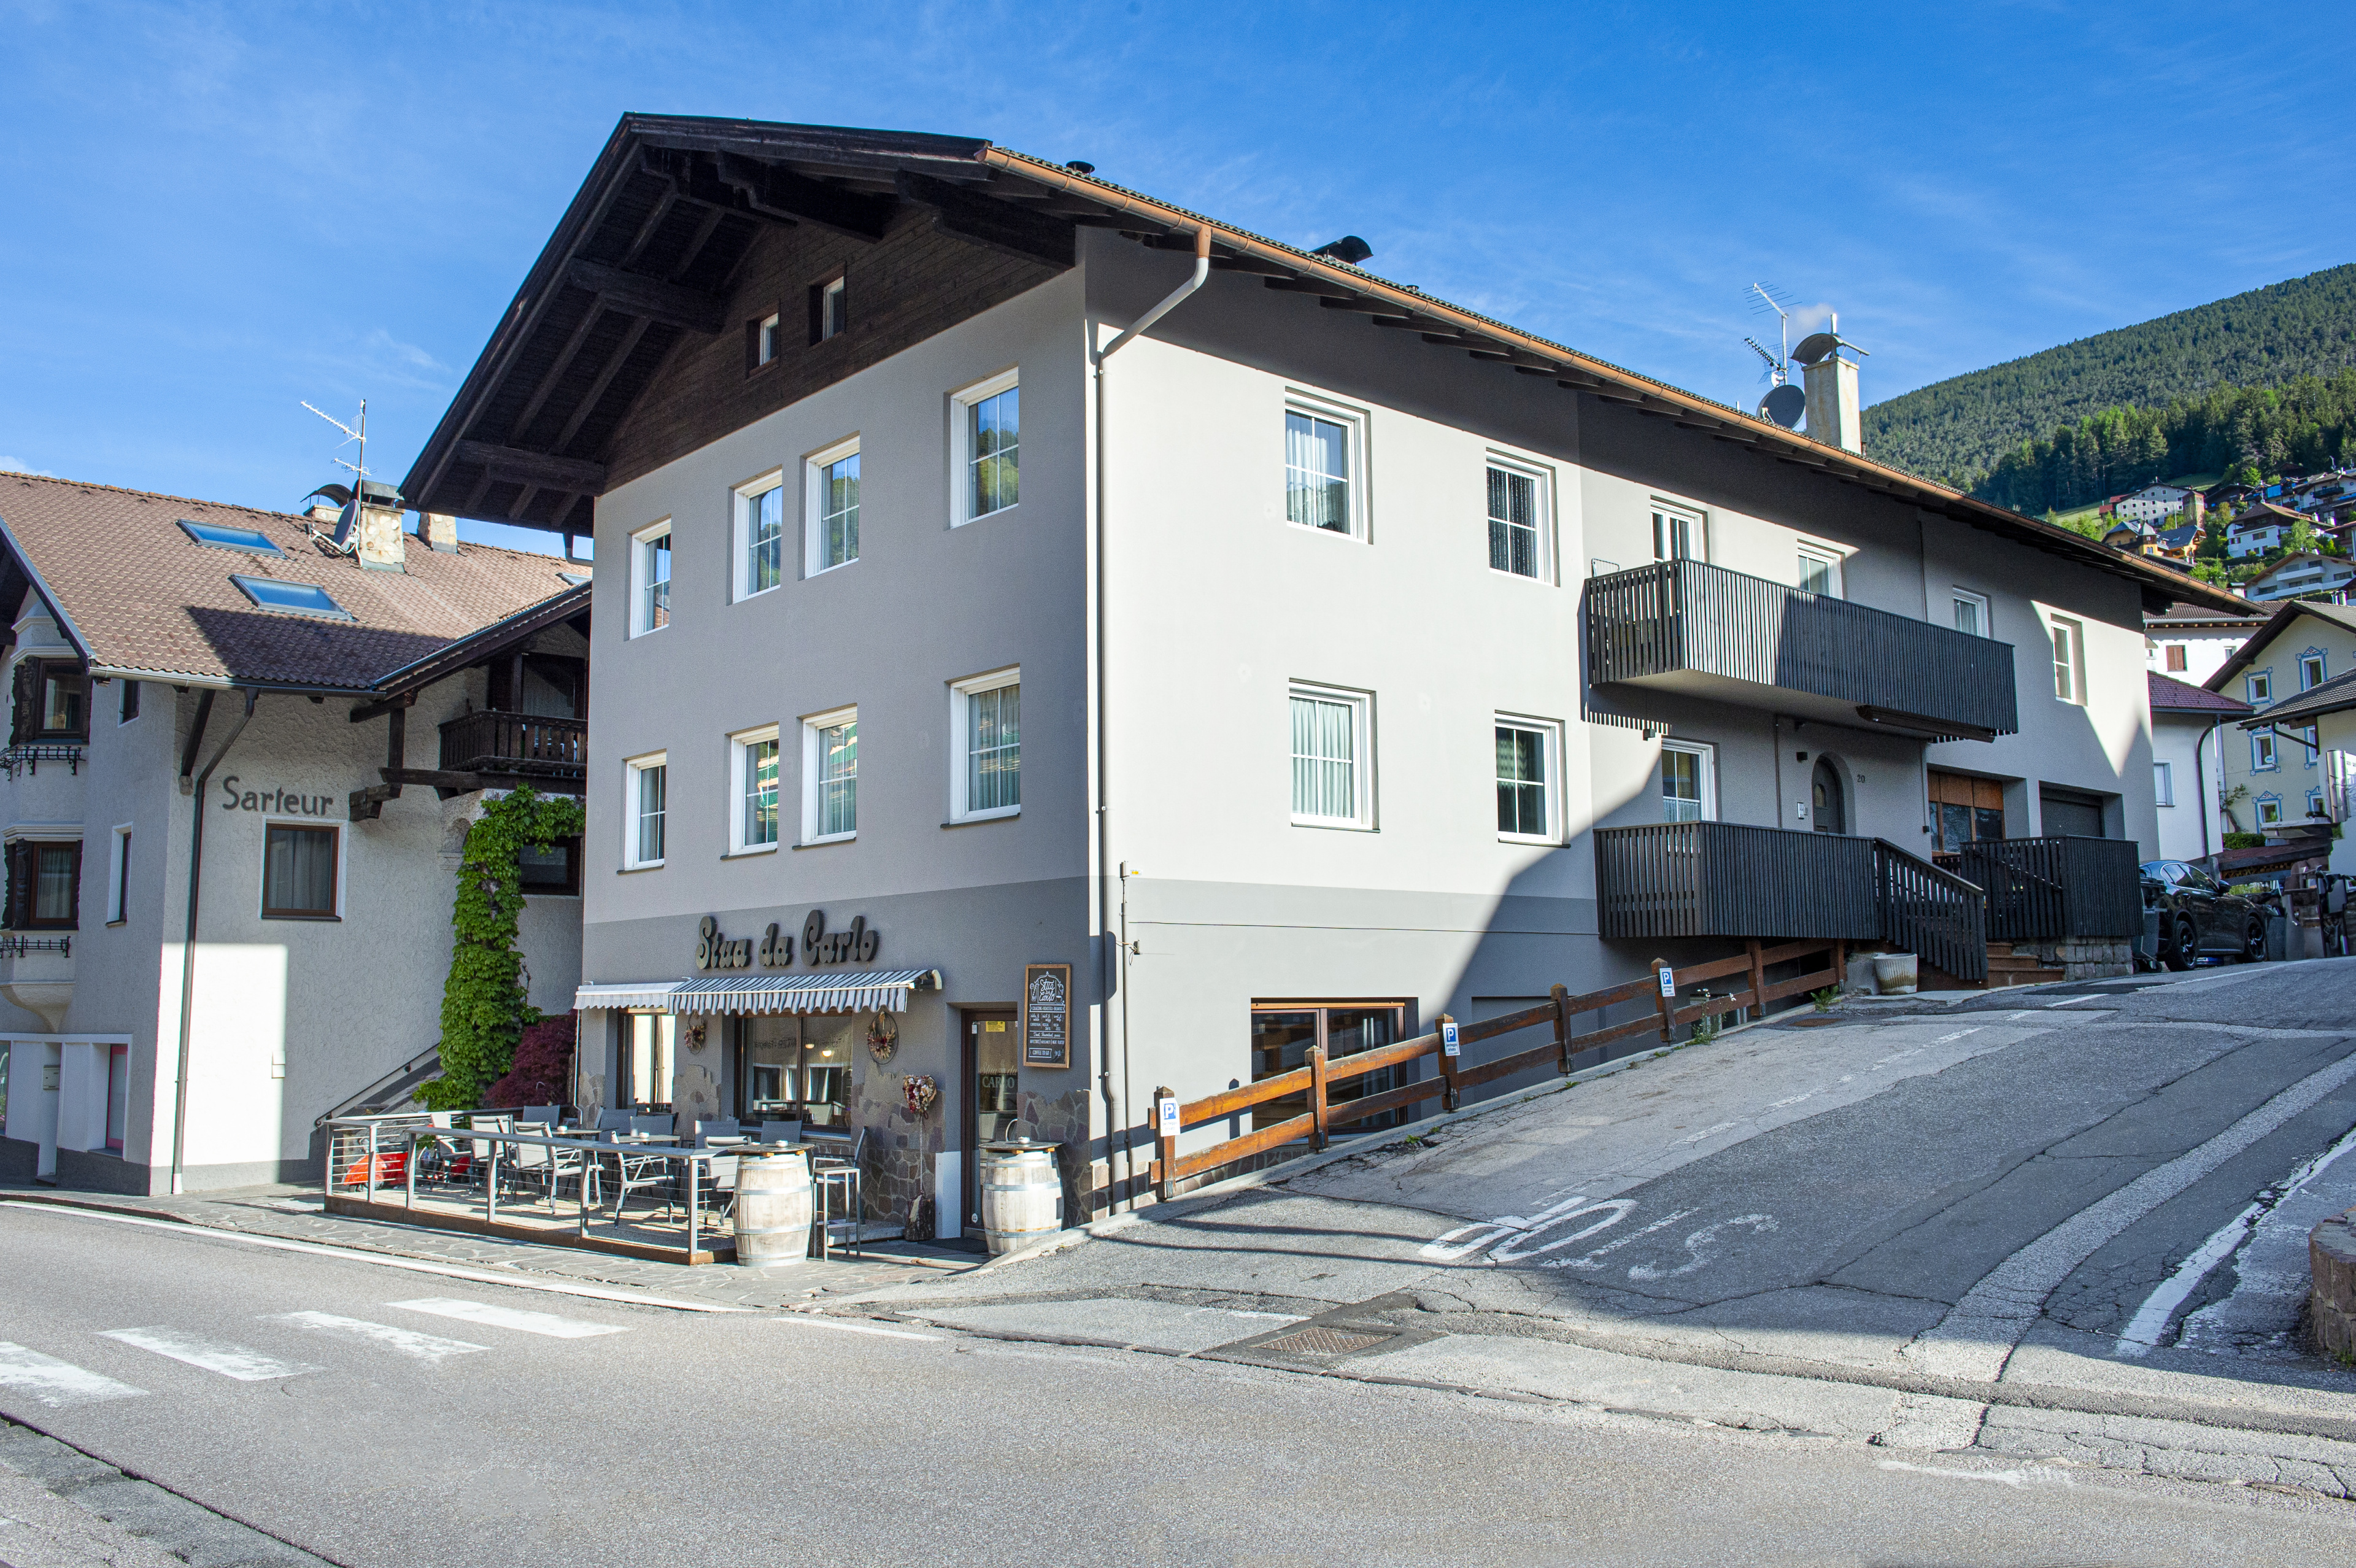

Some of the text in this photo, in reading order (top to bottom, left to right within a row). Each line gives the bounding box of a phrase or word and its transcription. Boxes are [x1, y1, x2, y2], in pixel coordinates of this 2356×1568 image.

[1857, 774, 1866, 783] 20
[222, 776, 334, 816] Sarteur
[695, 910, 878, 970] Stua da Carlo
[1040, 979, 1055, 991] Stua
[1663, 973, 1669, 984] P
[1039, 990, 1055, 1002] Carlo
[1447, 1028, 1454, 1041] P
[982, 1076, 1015, 1089] CARO
[1165, 1104, 1174, 1119] P
